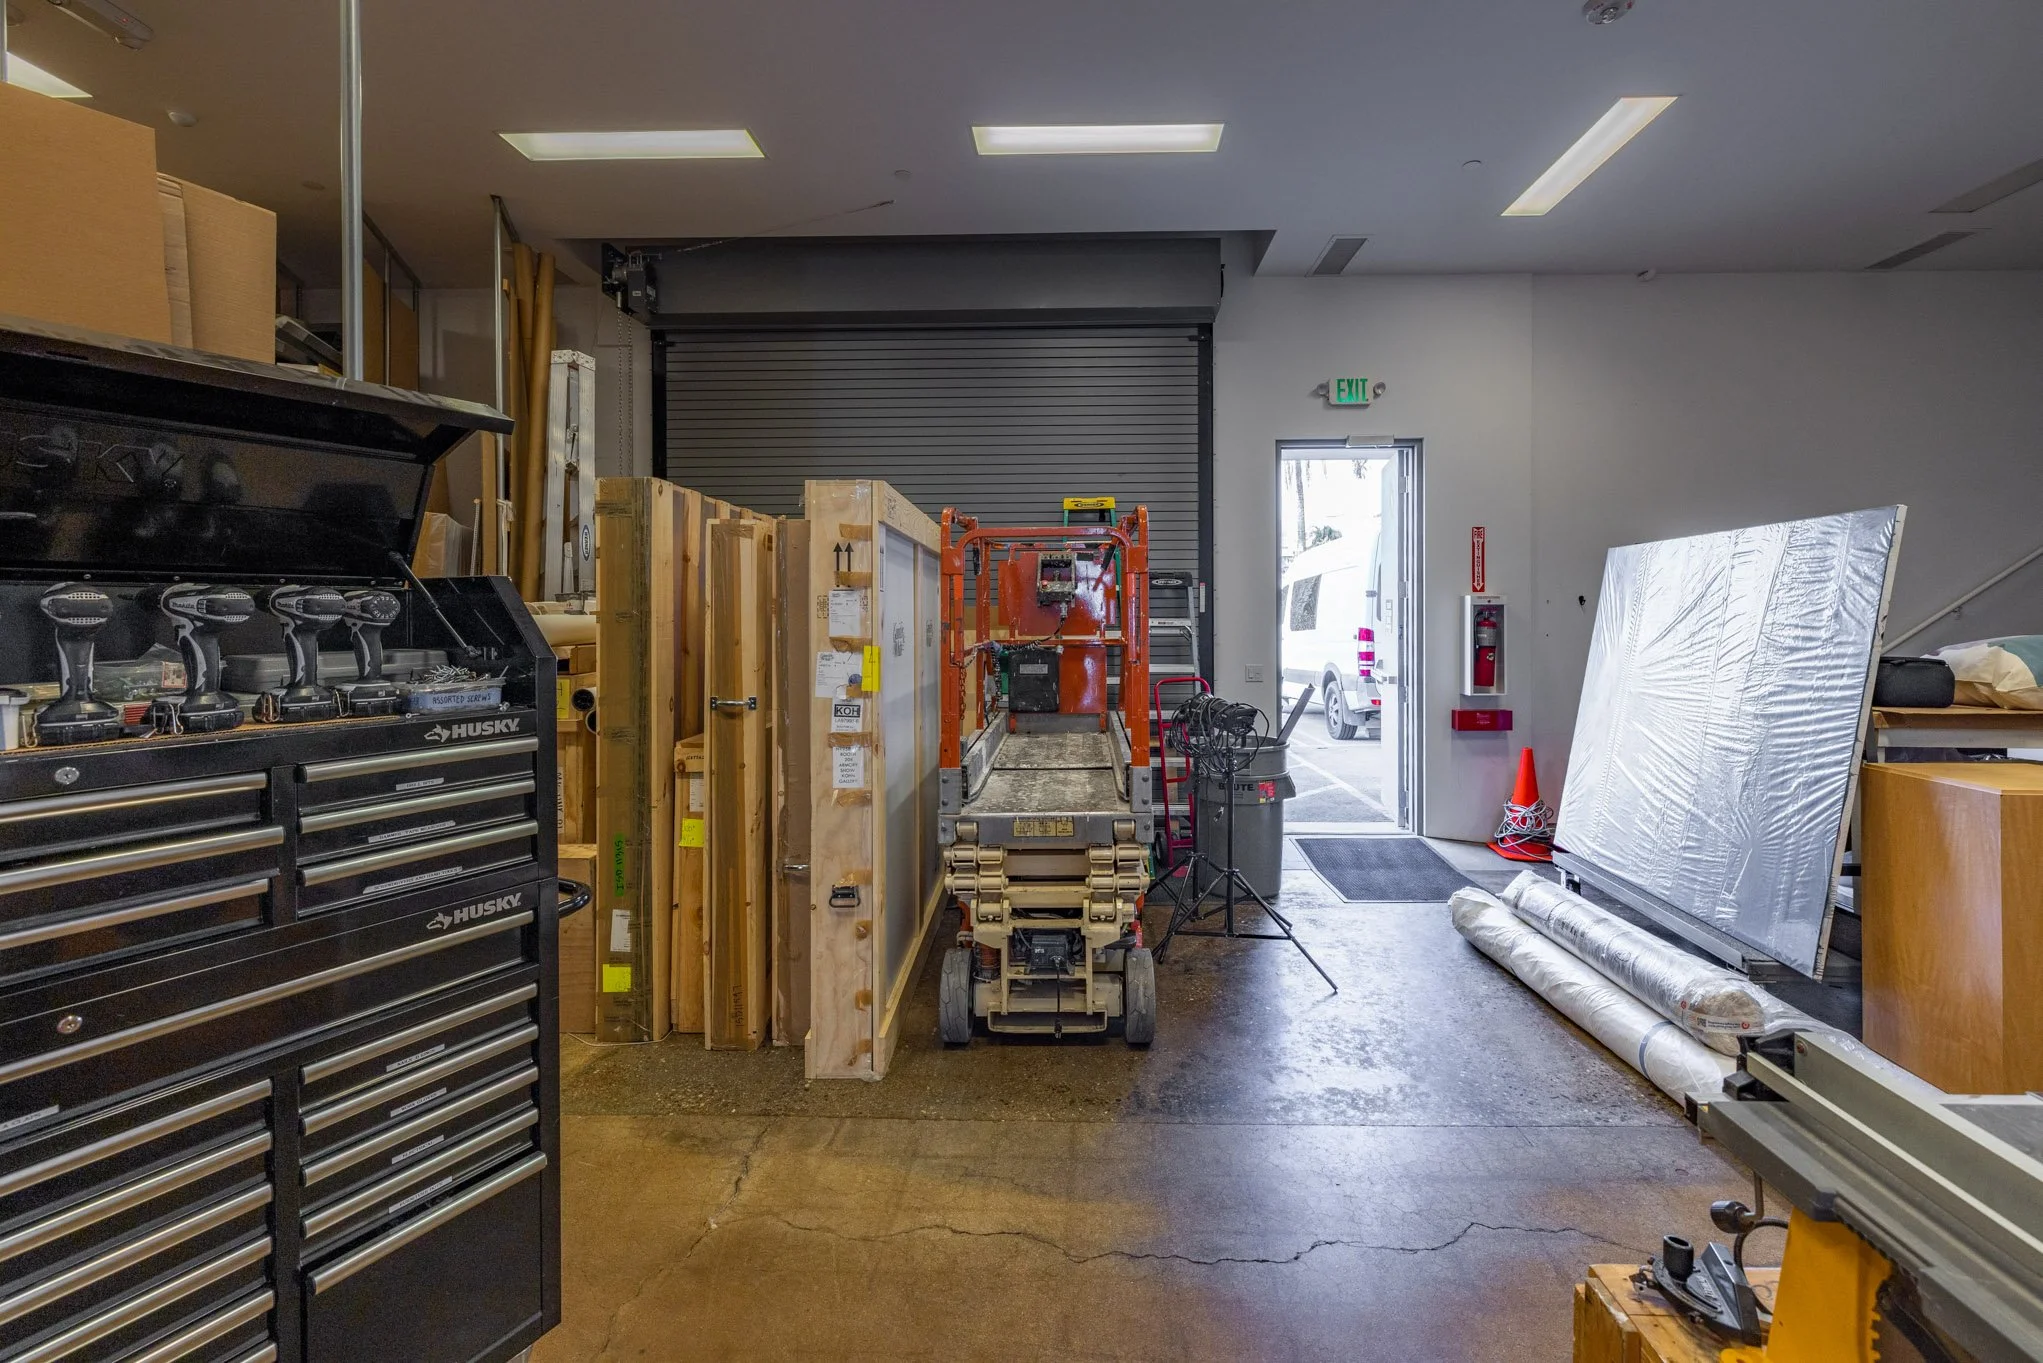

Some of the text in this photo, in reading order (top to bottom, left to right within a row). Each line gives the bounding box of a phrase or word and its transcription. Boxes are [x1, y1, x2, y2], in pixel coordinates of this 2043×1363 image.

[1336, 378, 1368, 402] EXIT
[432, 693, 491, 705] ASSORTED SCREWS
[452, 718, 520, 739] HUSKY
[1218, 782, 1254, 792] BUTE
[453, 892, 522, 925] HUSKY
